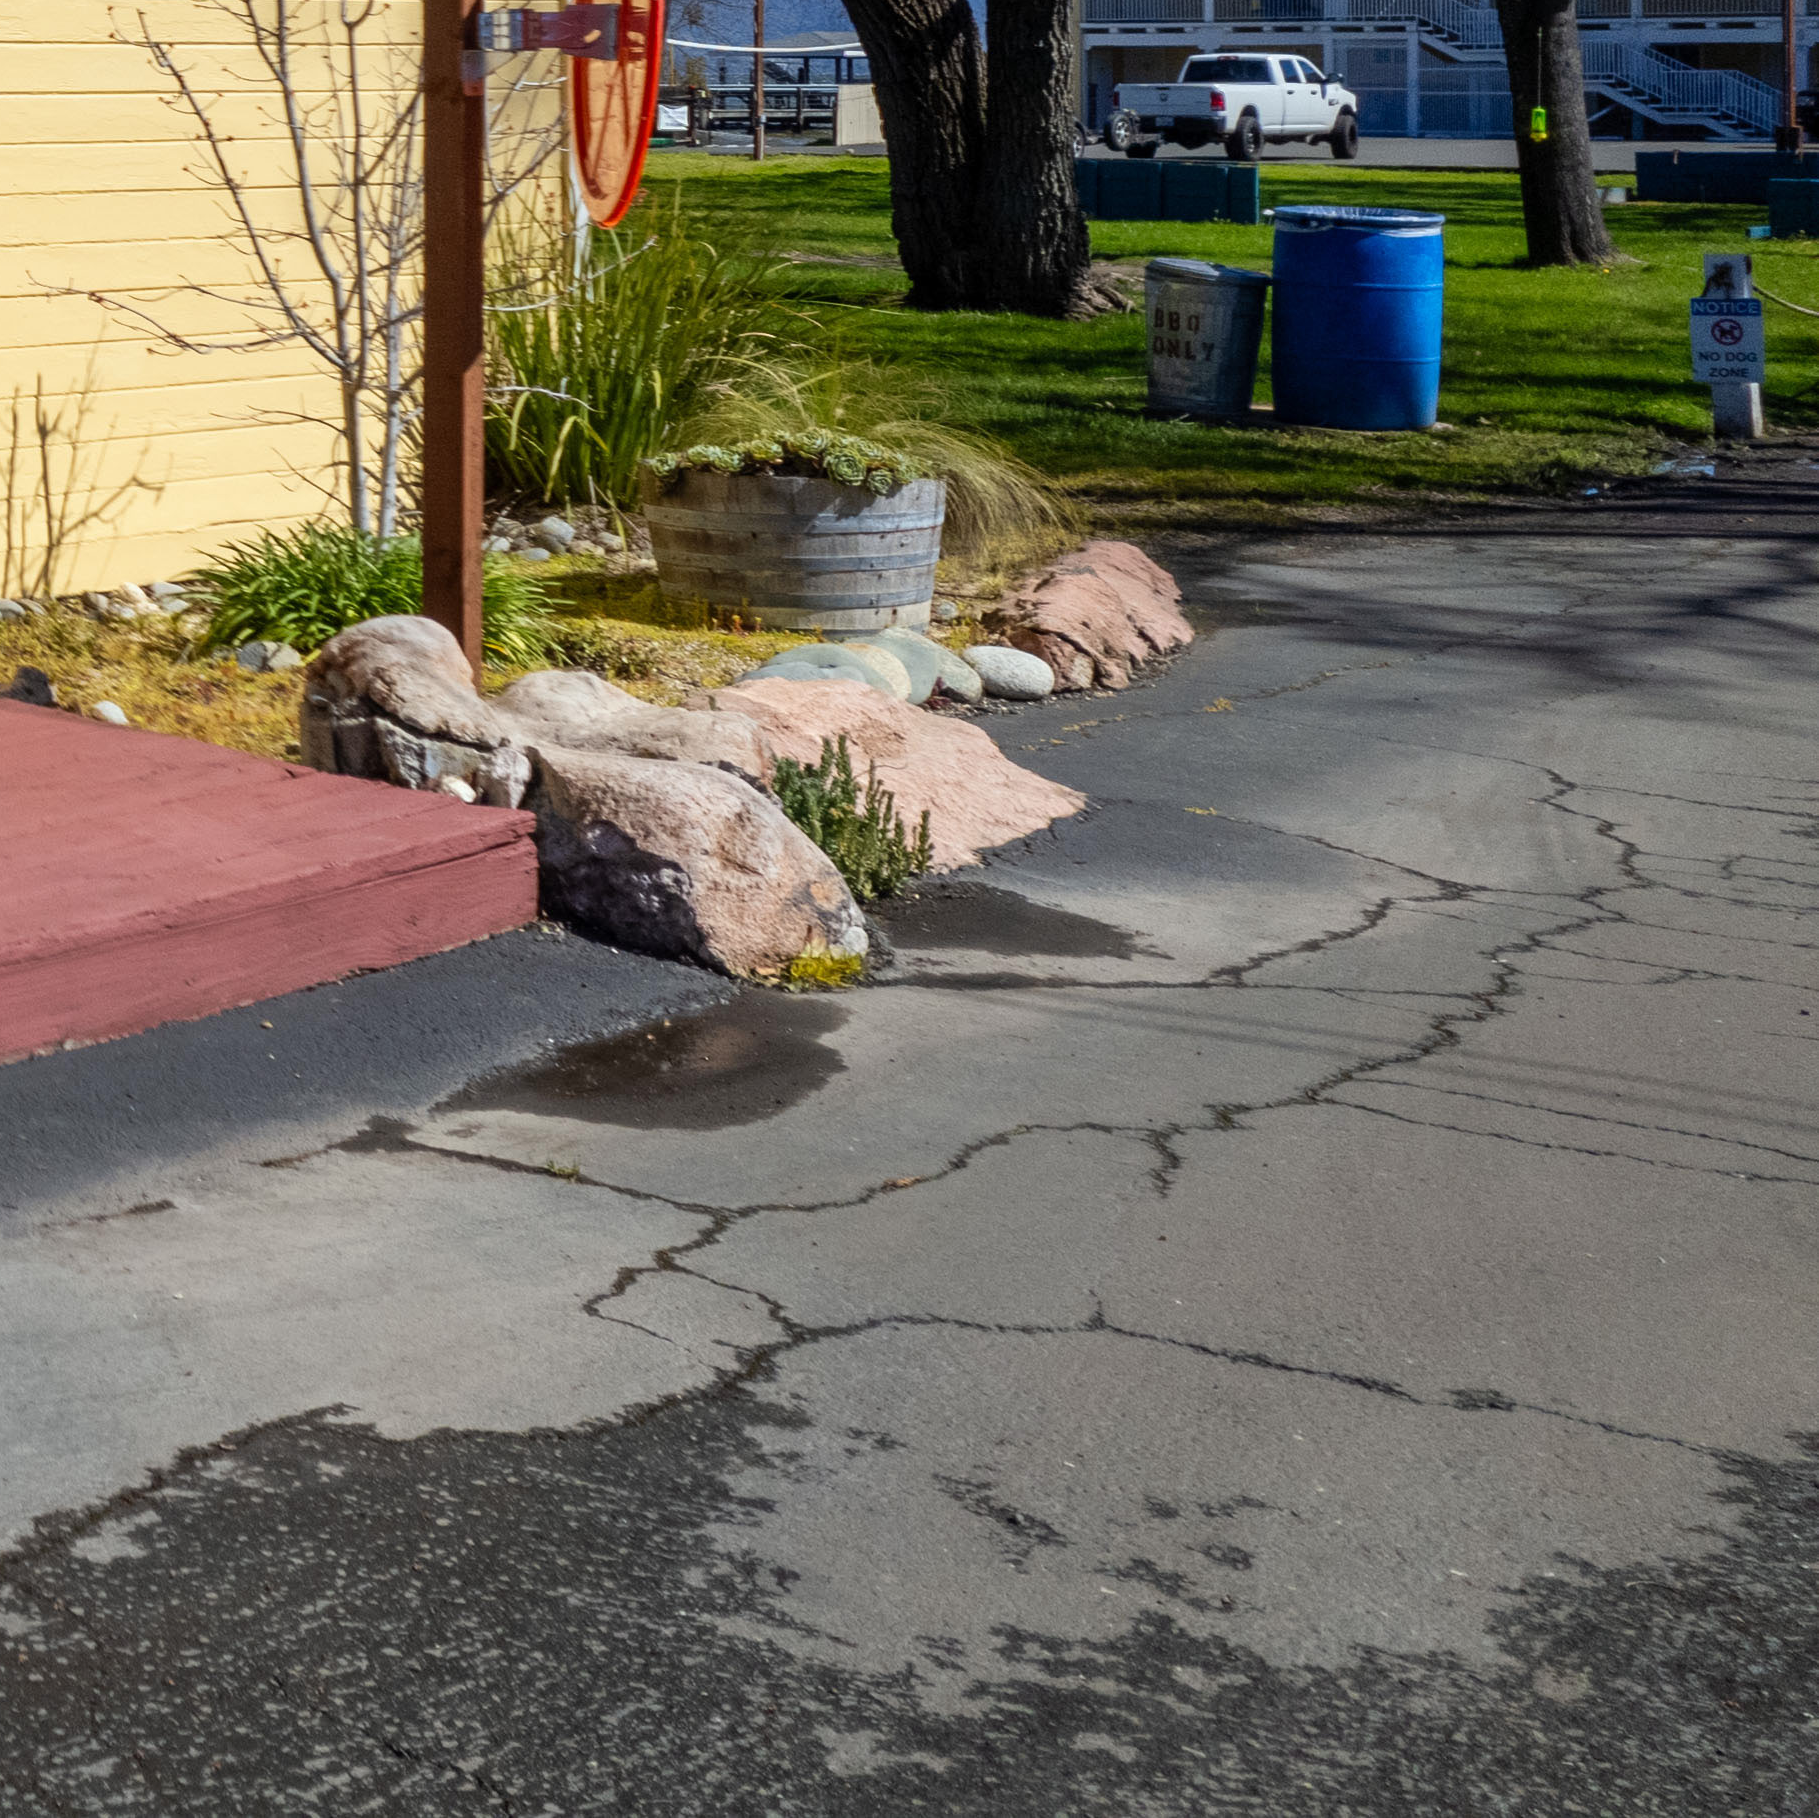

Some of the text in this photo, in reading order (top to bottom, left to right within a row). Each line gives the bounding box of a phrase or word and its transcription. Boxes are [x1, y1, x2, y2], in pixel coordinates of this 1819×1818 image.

[1694, 302, 1759, 314] NOTICE
[1154, 307, 1200, 335] BBQ
[1153, 336, 1215, 361] ONLY
[1698, 352, 1758, 362] NO DOG
[1709, 368, 1749, 378] ZONE
